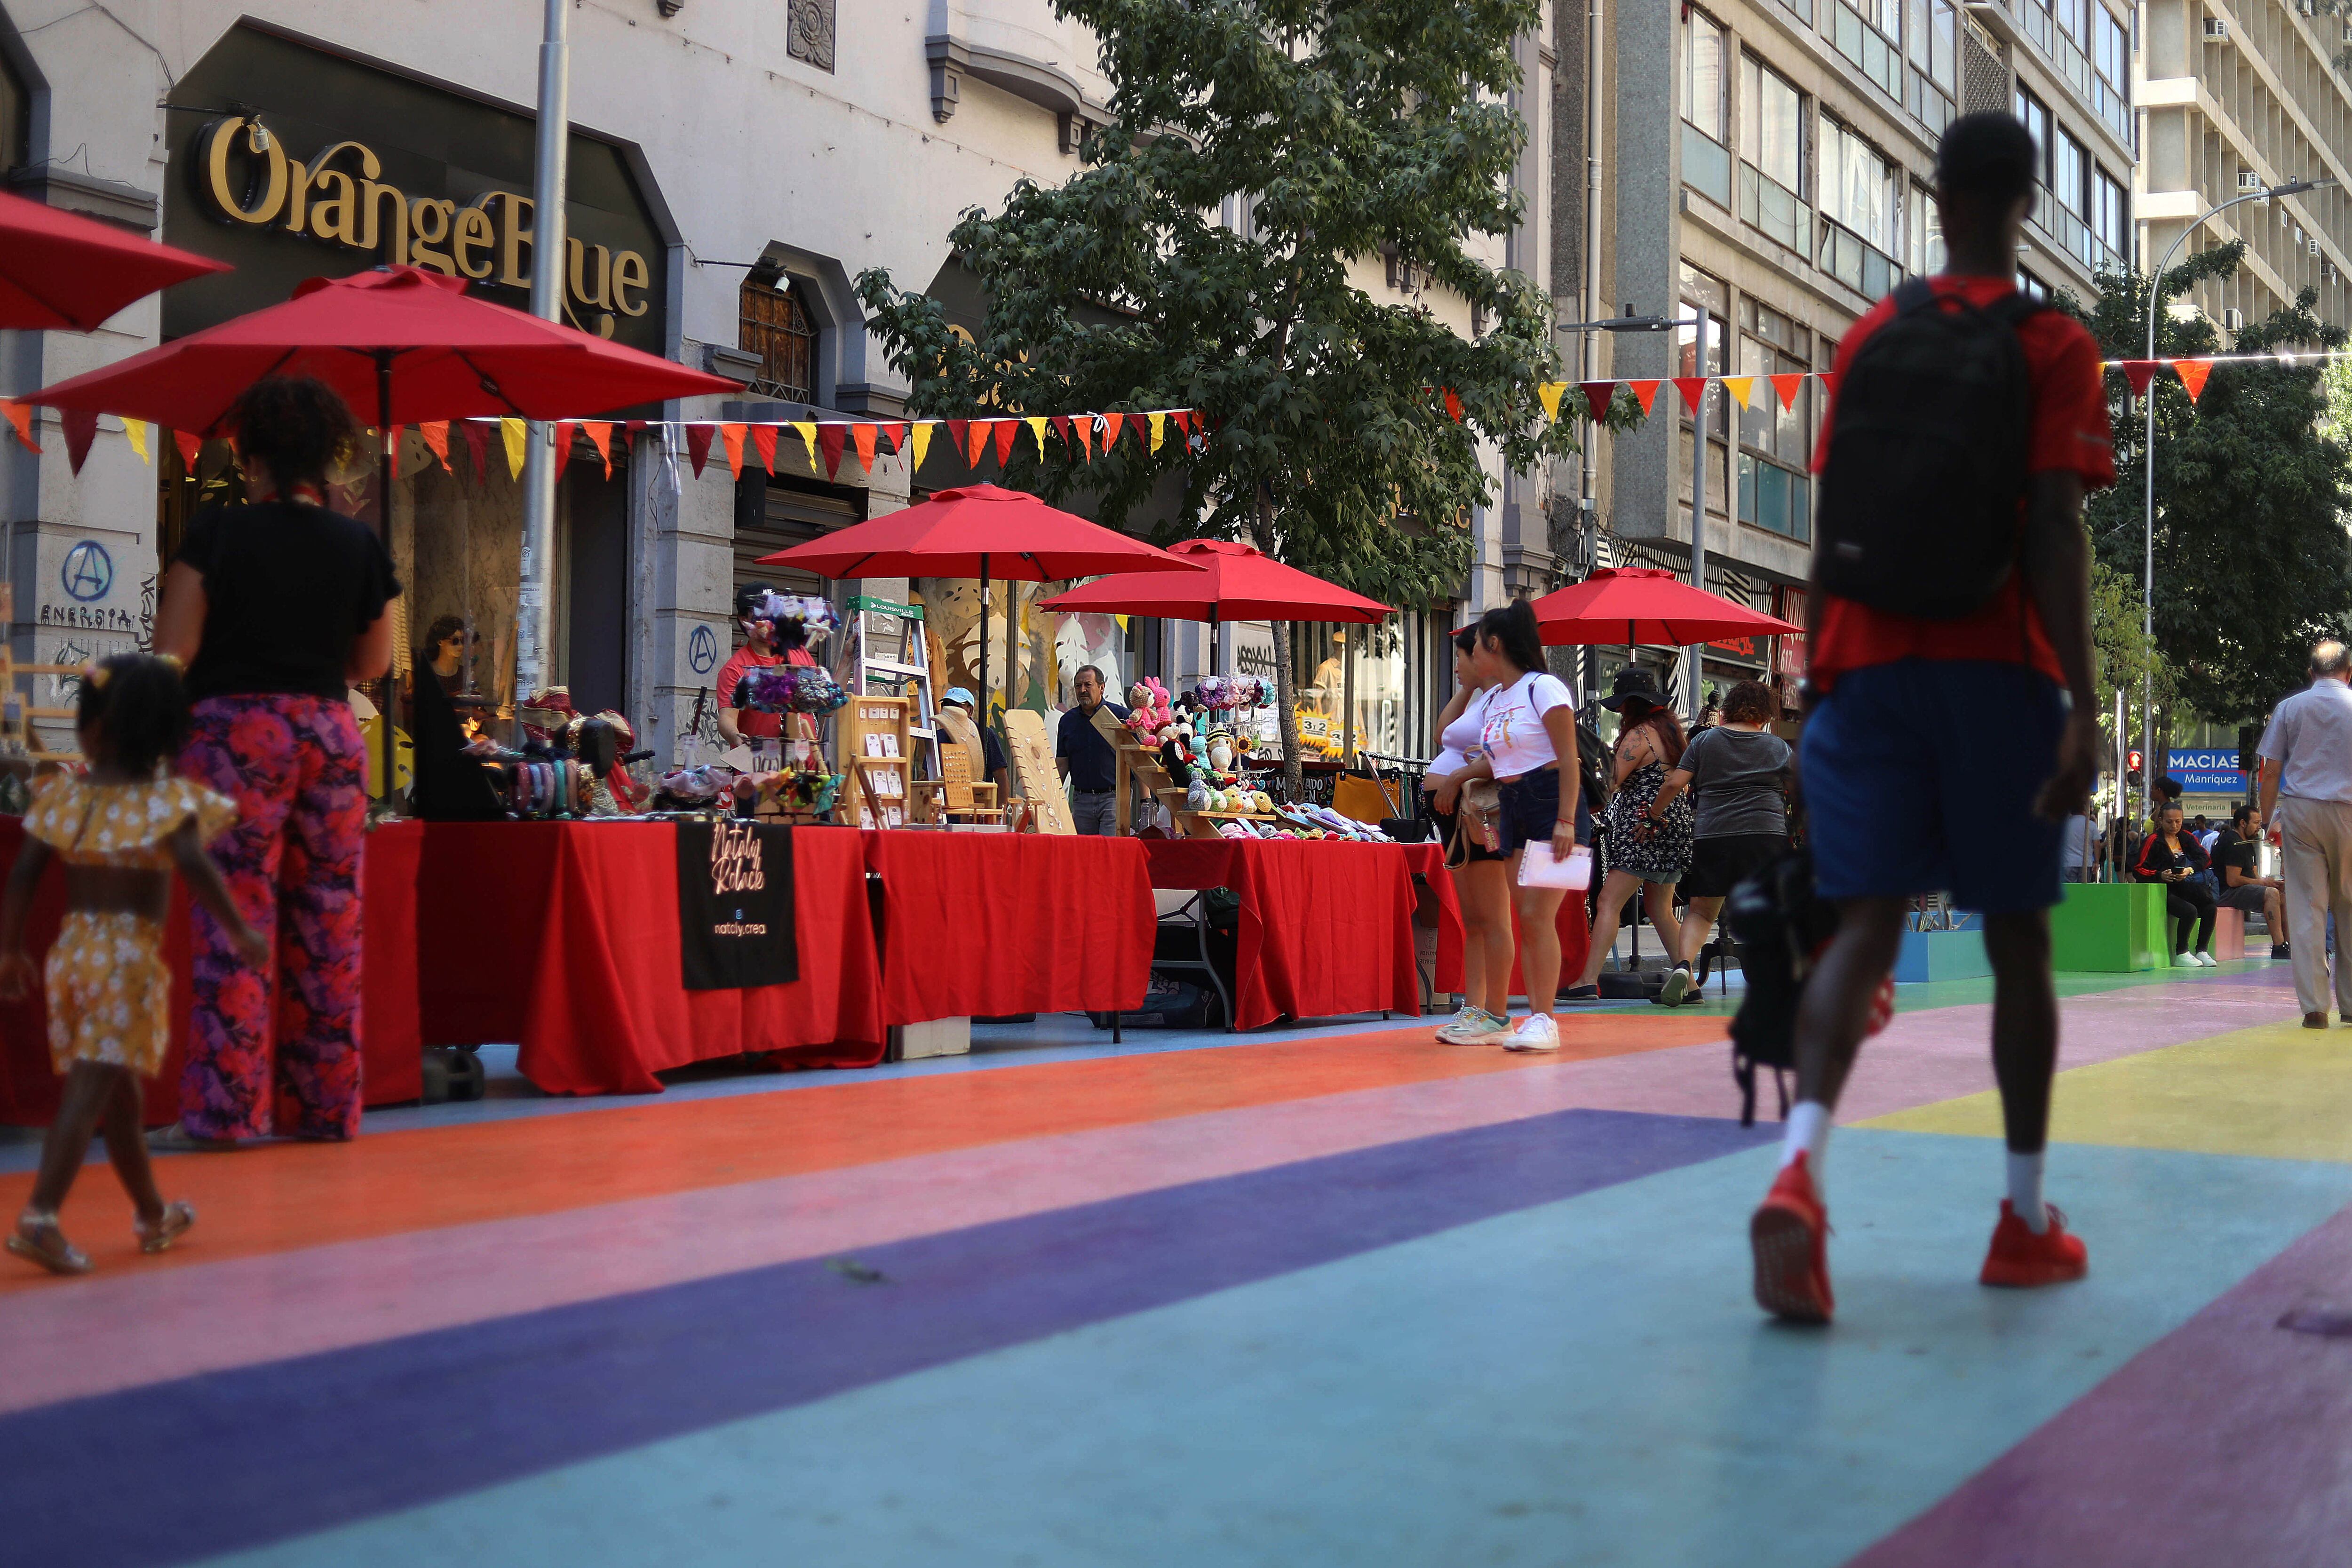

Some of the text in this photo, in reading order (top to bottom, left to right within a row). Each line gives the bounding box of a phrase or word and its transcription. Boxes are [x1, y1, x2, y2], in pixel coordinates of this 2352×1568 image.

[199, 116, 649, 340] OrangeBue
[876, 604, 914, 614] LOUISVILLE
[1304, 721, 1312, 729] 3
[1319, 722, 1326, 732] 2
[2167, 755, 2239, 769] MACIAS
[1276, 776, 1323, 790] MADO
[2185, 773, 2238, 786] Manríquez
[715, 921, 767, 937] nataly.crea
